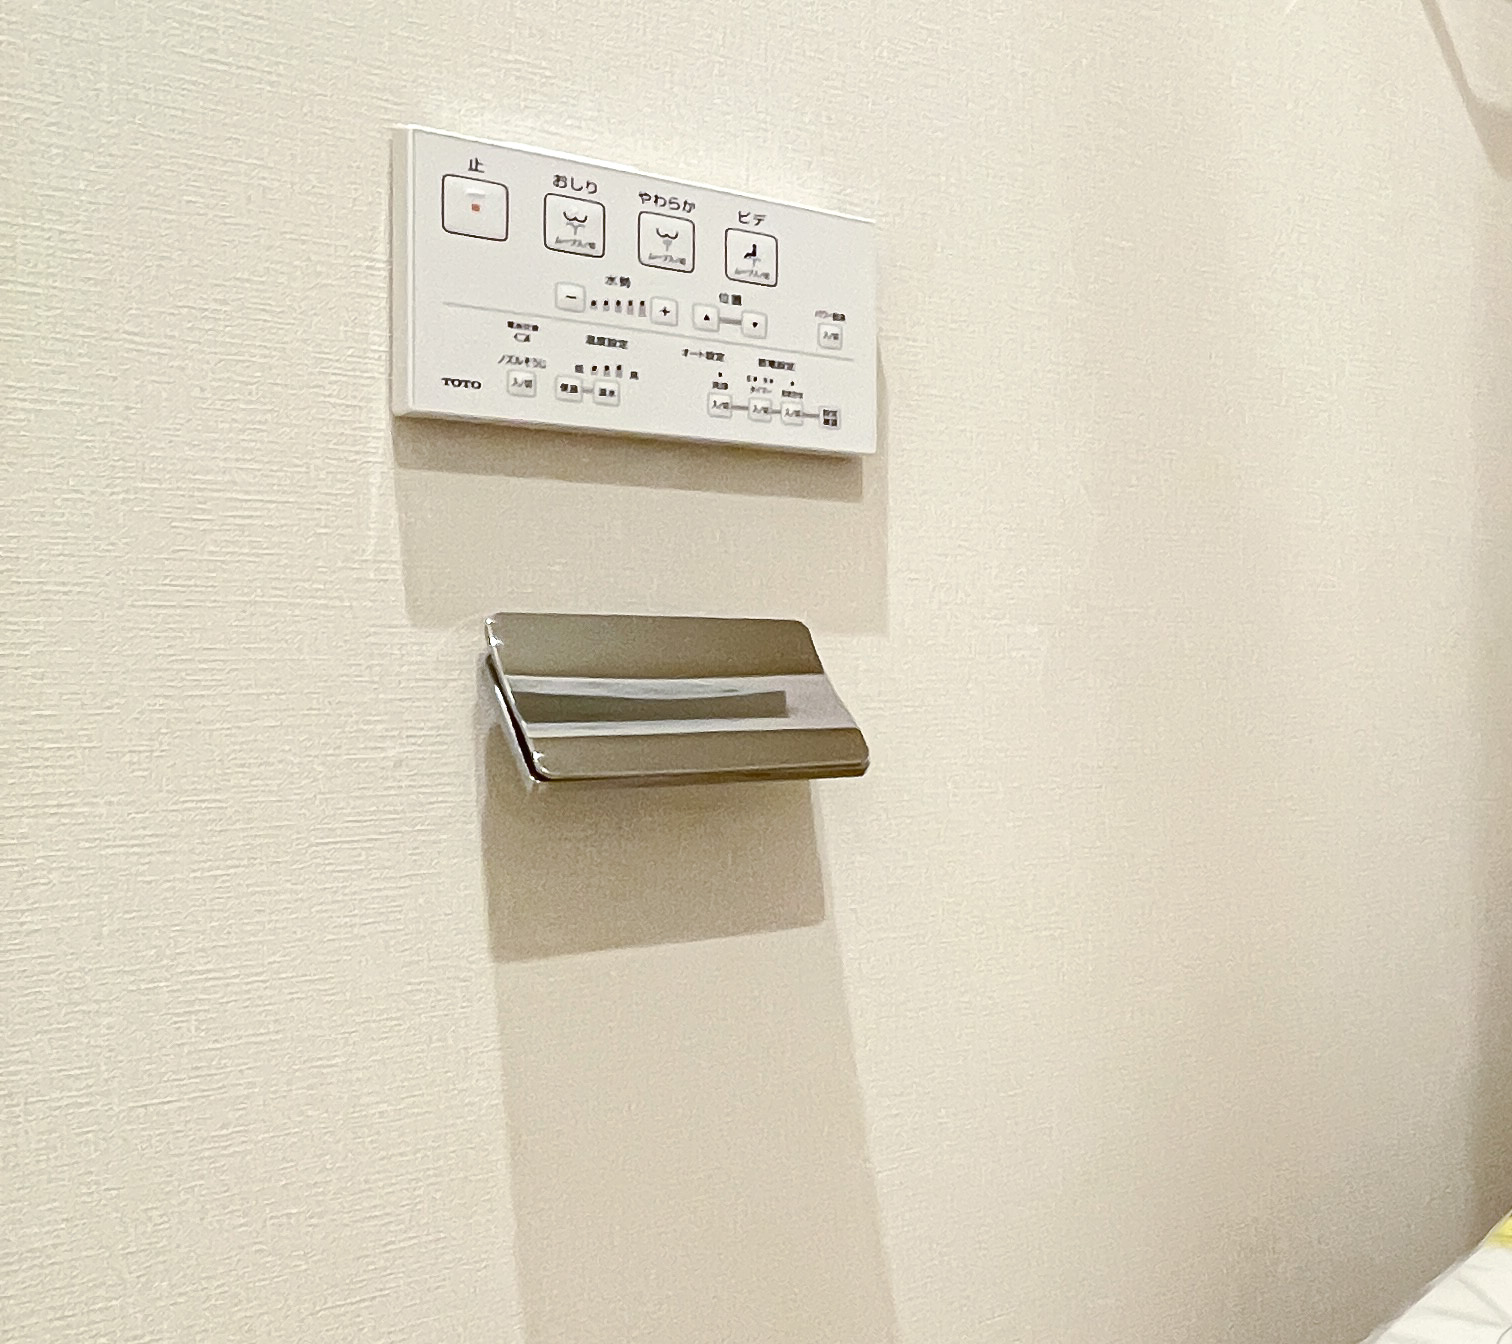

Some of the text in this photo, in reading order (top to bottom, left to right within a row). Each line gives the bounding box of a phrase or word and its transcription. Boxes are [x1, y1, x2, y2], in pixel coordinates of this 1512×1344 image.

[467, 157, 485, 173] 止
[553, 174, 598, 194] おしり
[639, 192, 696, 213] やわらか
[441, 377, 482, 390] TOTO
